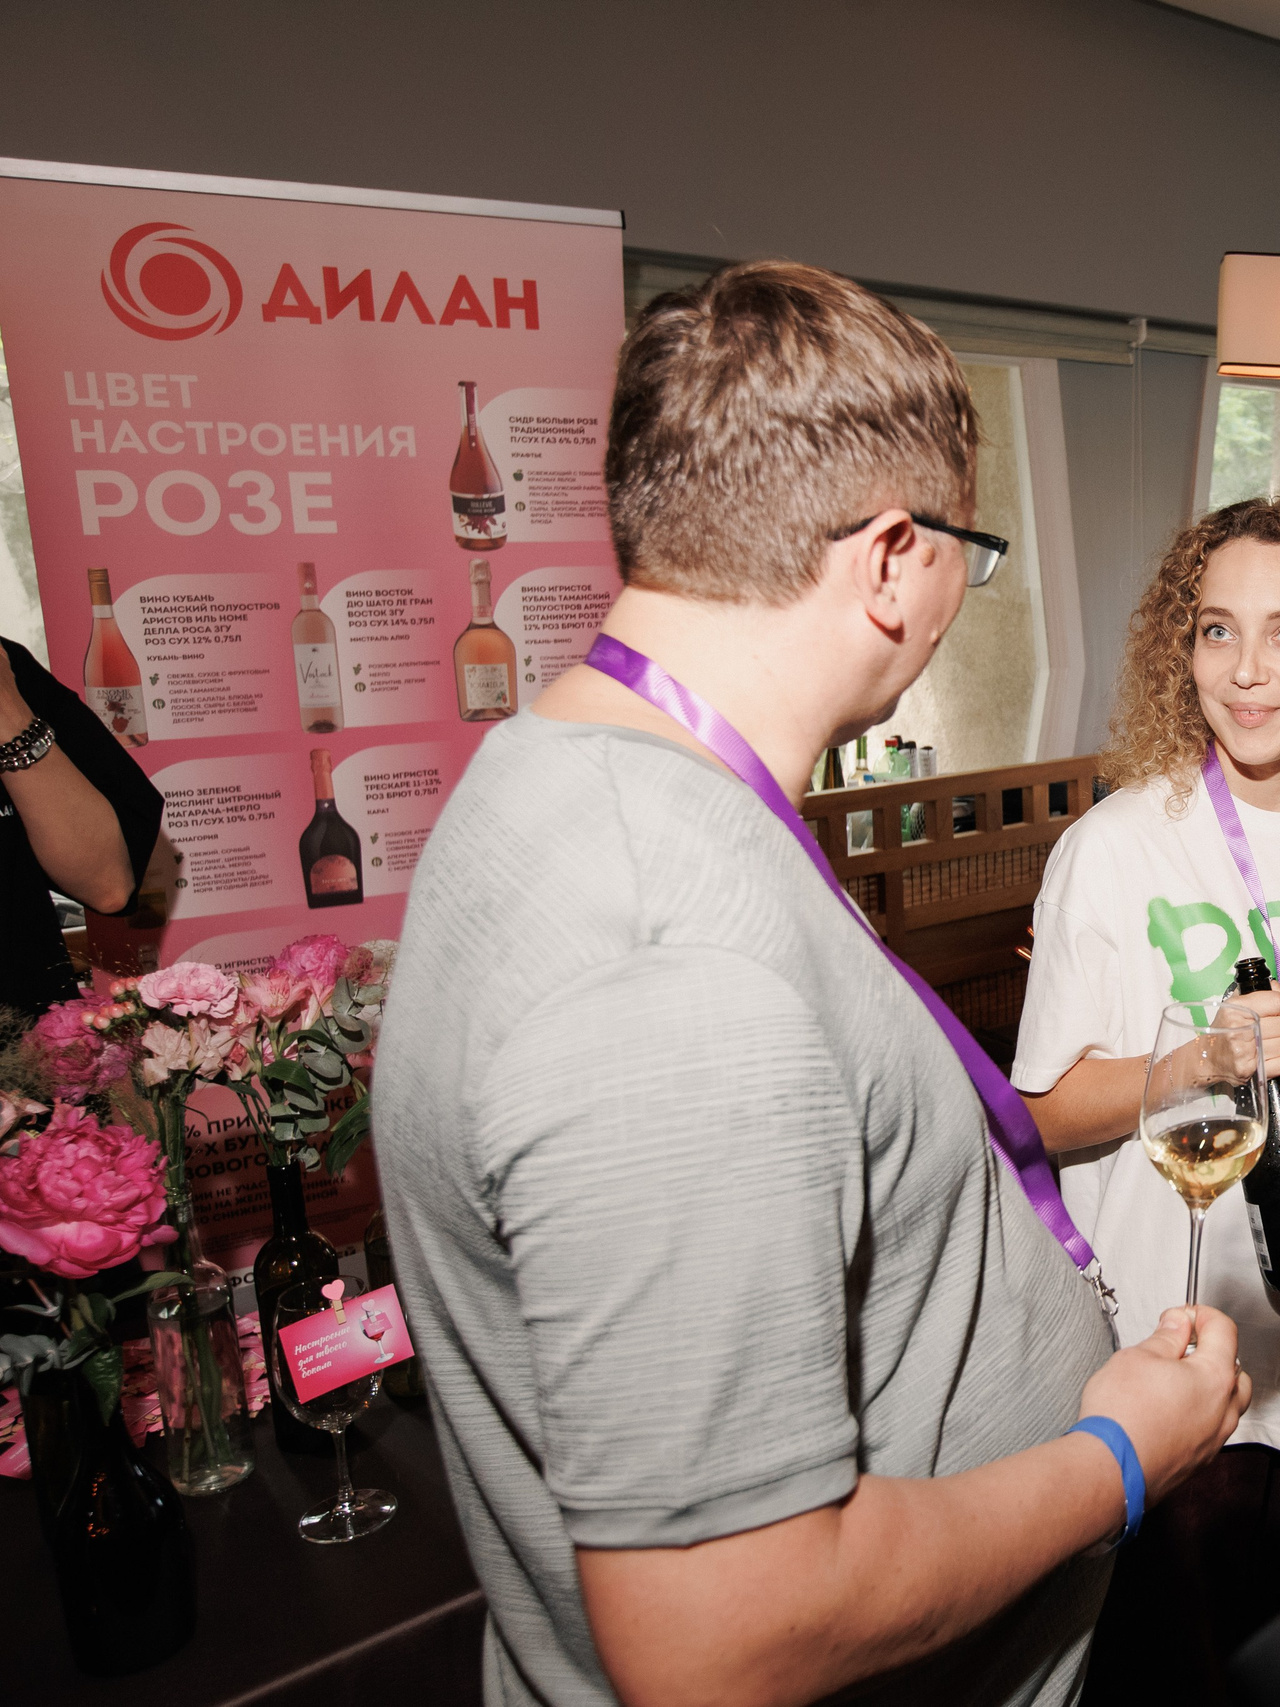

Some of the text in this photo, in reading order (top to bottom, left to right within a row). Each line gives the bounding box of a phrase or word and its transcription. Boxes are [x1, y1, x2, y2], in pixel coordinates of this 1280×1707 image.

[262, 263, 540, 330] ДИЛАН
[64, 371, 198, 410] ЦВЕТ
[509, 416, 534, 424] СИДР
[510, 426, 585, 434] ТРАДИЦИОННЫЙ
[70, 418, 418, 458] НАСТРОЕНИЯ
[510, 436, 539, 444] П/СУХ
[76, 469, 338, 536] РОЗЕ
[549, 584, 592, 592] ИГРИСТОЕ
[558, 592, 610, 601] ТАМАНСКИЙ
[141, 602, 280, 614] ТАМАНСКИЙ ПОЛУОСТРОВ
[348, 610, 386, 618] ВОСТОК
[523, 604, 582, 612] ПОЛУОСТРОВ
[143, 616, 193, 625] АРИСТОВ
[219, 614, 248, 622] НОМЕ
[370, 619, 388, 627] СУХ
[391, 618, 408, 626] 14%
[143, 625, 231, 635] ДЕЛЛА РОСА ЗГУ
[562, 622, 585, 630] БРЮТ
[193, 636, 212, 644] 12%
[364, 769, 439, 782] ВИНО ИГРИСТОЕ
[365, 778, 442, 791] ТРЕСКАРЕ 11-13%
[165, 785, 241, 798] ВИНО ЗЕЛЕНОЕ
[366, 793, 384, 801] РОЗ
[386, 790, 412, 799] БРЮТ
[166, 790, 281, 809] РИСЛИНГ ЦИТРОННЫЙ
[167, 803, 261, 818] МАГАРАЧА-МЕРЛО
[168, 820, 189, 828] РОЗ
[191, 817, 225, 827] П/СУХ
[226, 815, 246, 823] 10%
[170, 834, 218, 844] ФАНАГОРИЯ
[207, 1116, 250, 1134] ПРИ
[294, 1326, 351, 1355] Настроение
[298, 1340, 347, 1371] для твоего
[301, 1360, 332, 1379] бокала
